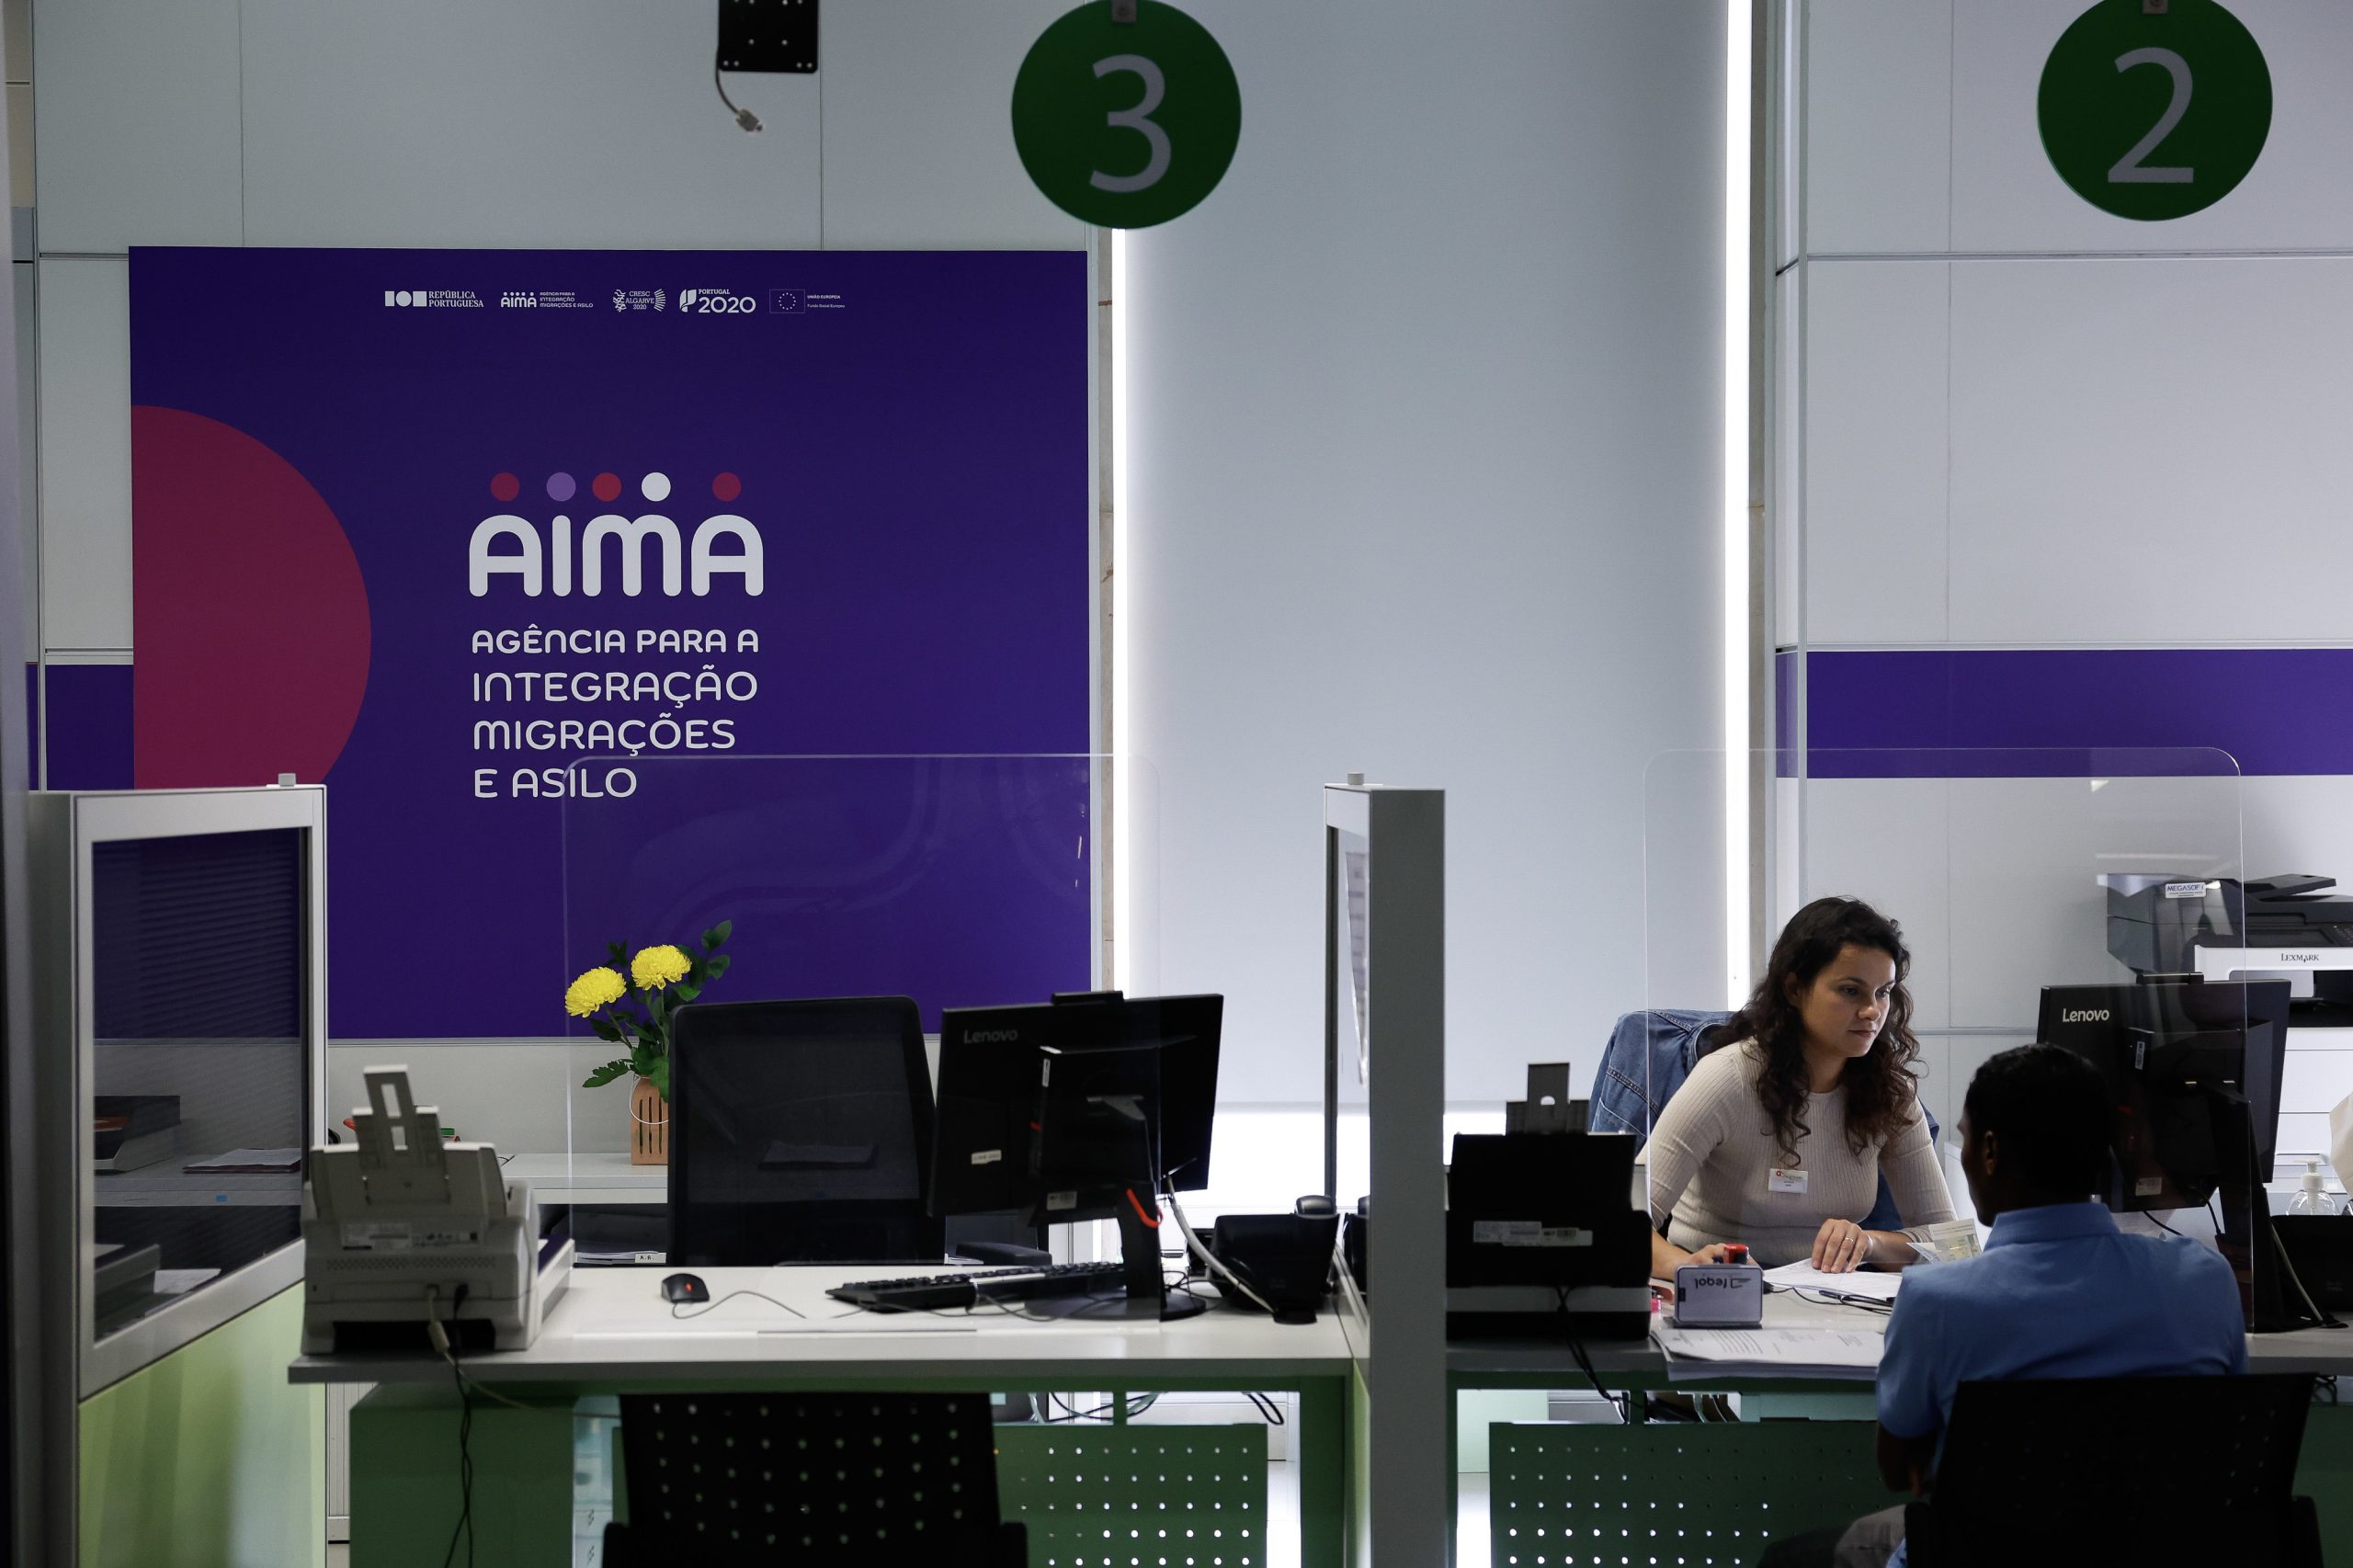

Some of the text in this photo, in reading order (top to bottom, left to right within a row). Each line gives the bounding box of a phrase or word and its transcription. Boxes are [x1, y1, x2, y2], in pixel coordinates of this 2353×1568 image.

[1089, 54, 1171, 193] 3
[2108, 47, 2194, 183] 2
[428, 290, 476, 299] REPÚBLICA
[428, 299, 484, 308] PORTUGUESA
[500, 296, 538, 308] AIMA
[698, 296, 756, 313] 2020
[469, 514, 764, 597] AIMA
[472, 623, 759, 654] AGÊNCIA PARA A
[473, 664, 758, 709] INTEGRAÇÃO
[473, 712, 736, 756] MIGRAÇÕES
[474, 767, 637, 798] E ASILO
[2280, 953, 2319, 962] LEXMARK
[2063, 1008, 2110, 1023] Lenovo
[963, 1028, 1018, 1044] Lenovo
